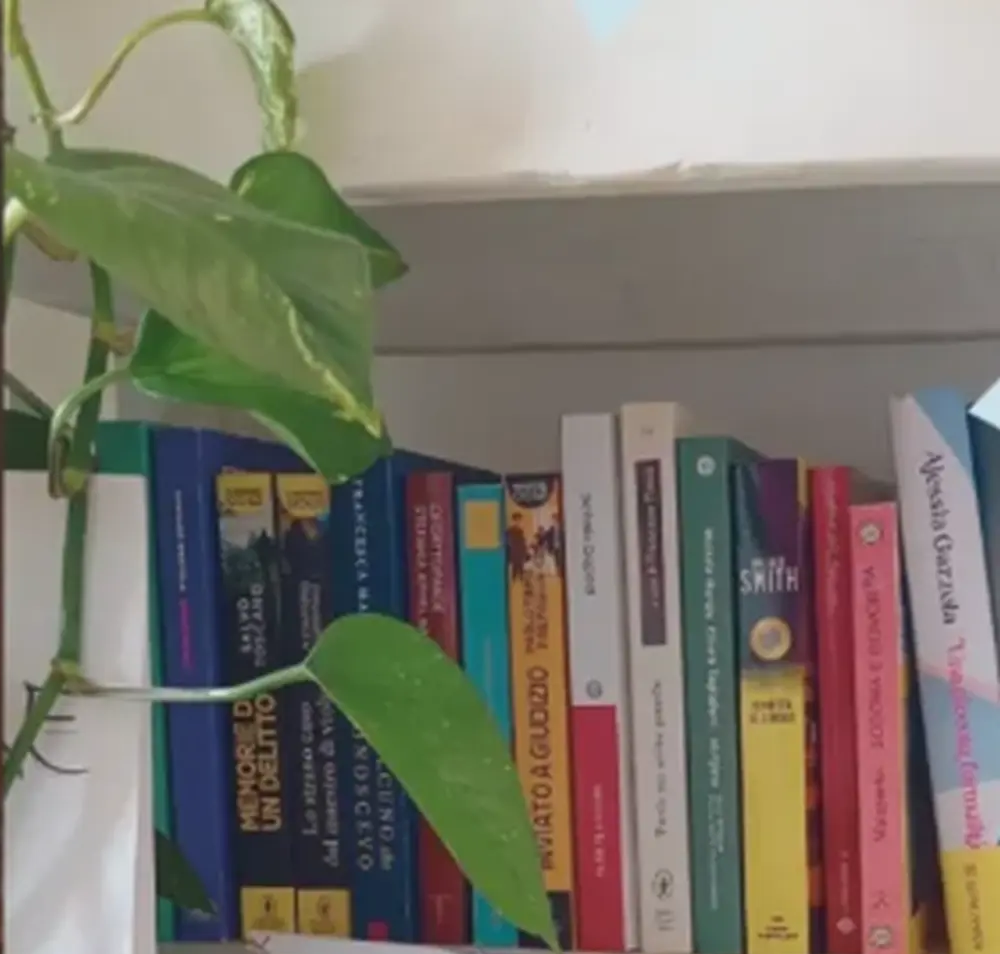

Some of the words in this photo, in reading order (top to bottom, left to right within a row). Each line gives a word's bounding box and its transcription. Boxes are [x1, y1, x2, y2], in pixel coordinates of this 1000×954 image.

[740, 566, 799, 596] SMITH
[255, 694, 280, 791] DELITTO
[234, 722, 259, 831] MEMORIE
[259, 797, 282, 831] UN
